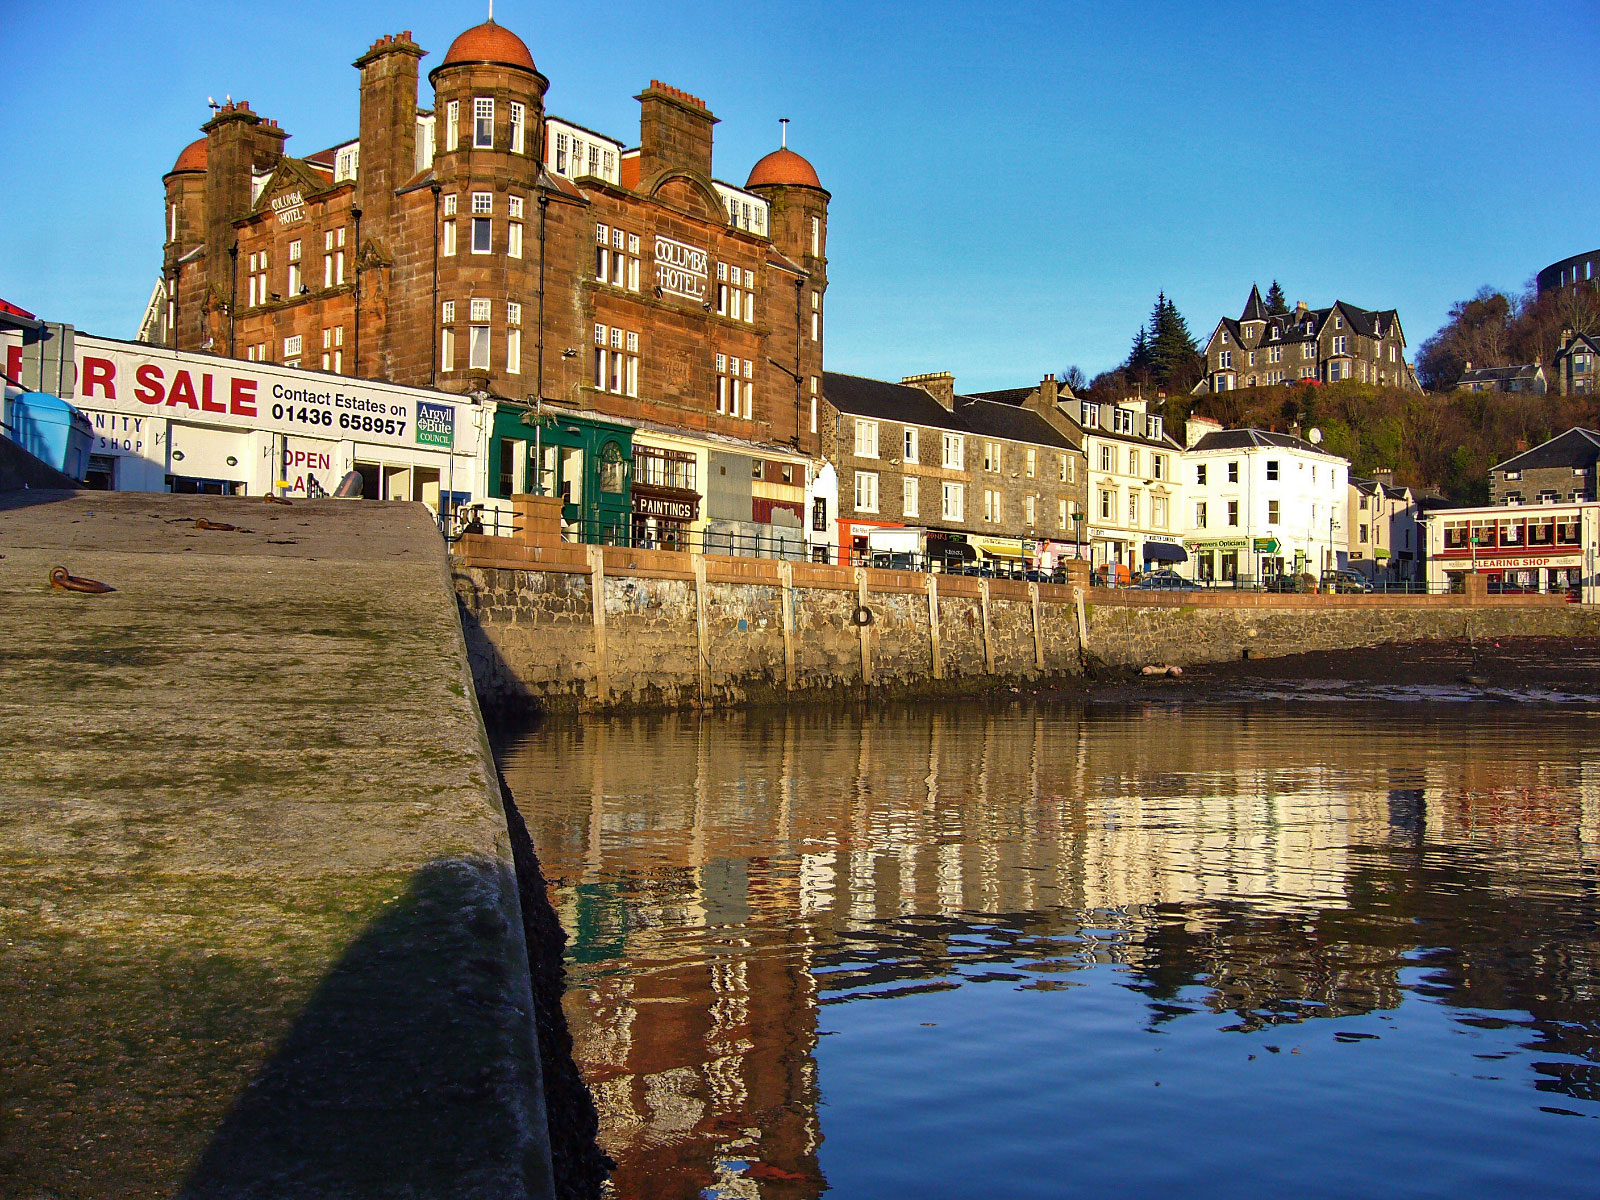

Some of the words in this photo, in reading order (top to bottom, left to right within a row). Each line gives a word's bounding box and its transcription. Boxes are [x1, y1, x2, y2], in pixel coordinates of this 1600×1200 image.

[271, 191, 303, 211] COLUMBA
[280, 208, 303, 226] HOTEL
[655, 240, 708, 275] COLUMBA
[660, 266, 703, 297] HOTEL
[6, 344, 117, 400] FR
[133, 363, 258, 418] SALE
[272, 384, 331, 406] Contact
[335, 393, 386, 414] Estates
[390, 405, 407, 417] on
[86, 412, 143, 433] NITY
[271, 403, 333, 427] 01436
[339, 412, 407, 437] 658957
[419, 404, 452, 424] Argyll
[426, 418, 452, 435] Bute
[100, 436, 143, 452] SHOP
[420, 432, 451, 444] COUNCIL
[282, 449, 330, 470] OPEN
[640, 499, 691, 517] PAINTINGS
[1522, 558, 1550, 567] SHOP
